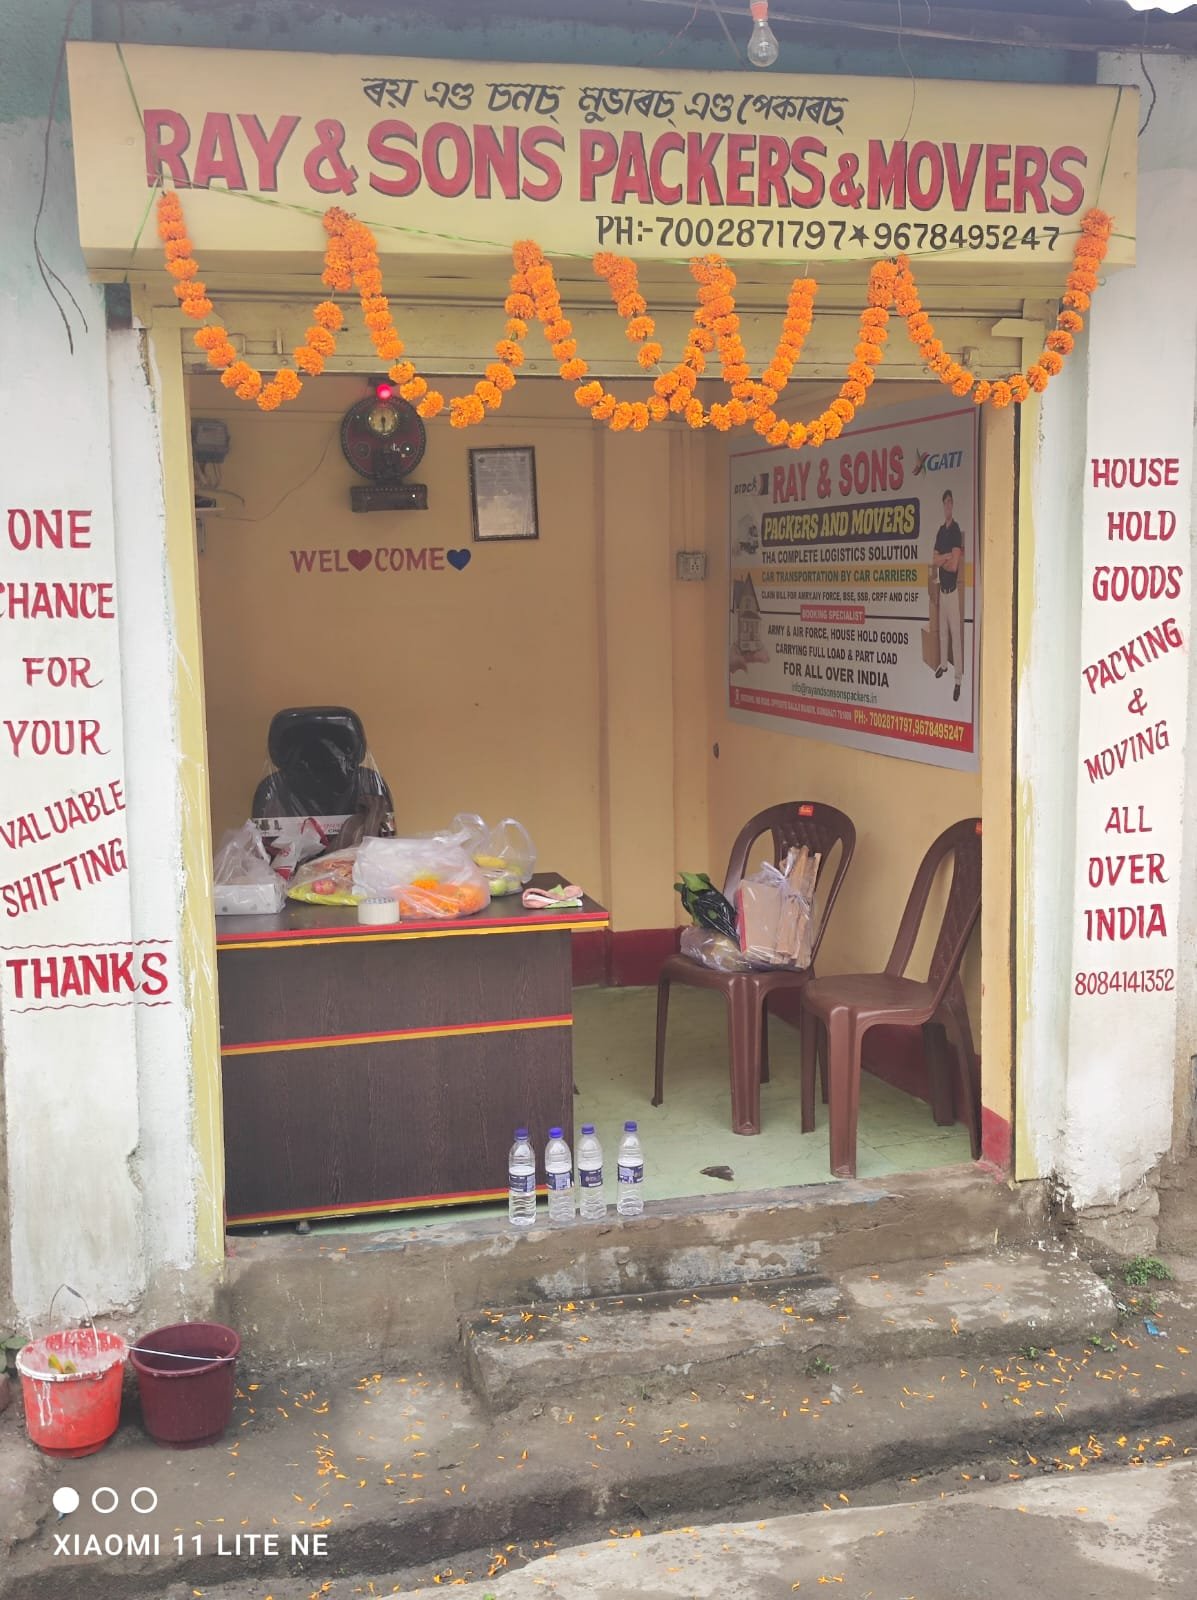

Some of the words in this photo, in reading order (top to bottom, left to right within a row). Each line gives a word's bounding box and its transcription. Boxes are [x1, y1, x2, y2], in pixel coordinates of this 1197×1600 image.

[425, 81, 474, 110] এণ্ড
[684, 92, 734, 122] এণ্ড
[143, 107, 302, 192] RAY
[303, 118, 358, 196] &
[367, 119, 566, 201] SONS
[579, 129, 827, 209] PACKERS
[830, 152, 864, 209] &
[867, 139, 1087, 215] MOVERS
[773, 460, 810, 504] RAY
[817, 458, 832, 499] &
[839, 445, 905, 496] SONS
[1091, 458, 1179, 488] HOUSE
[8, 509, 92, 550] ONE
[763, 513, 818, 542] PACKERS
[821, 511, 848, 537] AND
[851, 504, 915, 535] MOVERS
[1107, 511, 1176, 541] HOLD
[762, 551, 776, 564] THA
[778, 549, 818, 564] COMPLETE
[820, 547, 866, 563] LOGISTICS
[868, 545, 918, 561] SOLUTION
[762, 571, 774, 582] CAR
[776, 570, 839, 583] TRANSPORTATION
[840, 570, 850, 582] BY
[854, 569, 870, 582] CAR
[873, 569, 917, 582] CARRIERS
[1092, 565, 1183, 602] GOODS
[889, 592, 902, 602] AND
[904, 592, 919, 602] CISF
[801, 609, 827, 619] BOOKING
[828, 610, 863, 621] SPECIALIST
[768, 625, 784, 636] ARMY
[793, 626, 803, 637] AIR
[805, 627, 829, 640] FORCE,
[831, 629, 855, 641] HOUSE
[857, 631, 878, 643] HOLD
[880, 632, 909, 645] GOODS
[776, 643, 807, 656] CARRYING
[809, 646, 826, 659] FULL
[827, 648, 845, 660] LOAD
[848, 650, 853, 661] &
[855, 650, 874, 663] PART
[876, 652, 897, 665] LOAD
[1082, 618, 1183, 694] PACKING
[22, 657, 104, 688] FOR
[783, 662, 802, 677] FOR
[804, 664, 823, 679] ALL
[825, 667, 854, 683] OVER
[857, 670, 889, 688] INDIA
[1128, 688, 1148, 716] &
[3, 720, 111, 758] YOUR
[1083, 720, 1169, 784] MOVING
[0, 779, 126, 850] VALUABLE
[1105, 806, 1152, 834] ALL
[0, 838, 128, 917] SHIFTING
[1088, 853, 1169, 888] OVER
[1084, 904, 1167, 941] INDIA
[6, 951, 168, 999] THANKS
[1074, 968, 1175, 995] 8084141352
